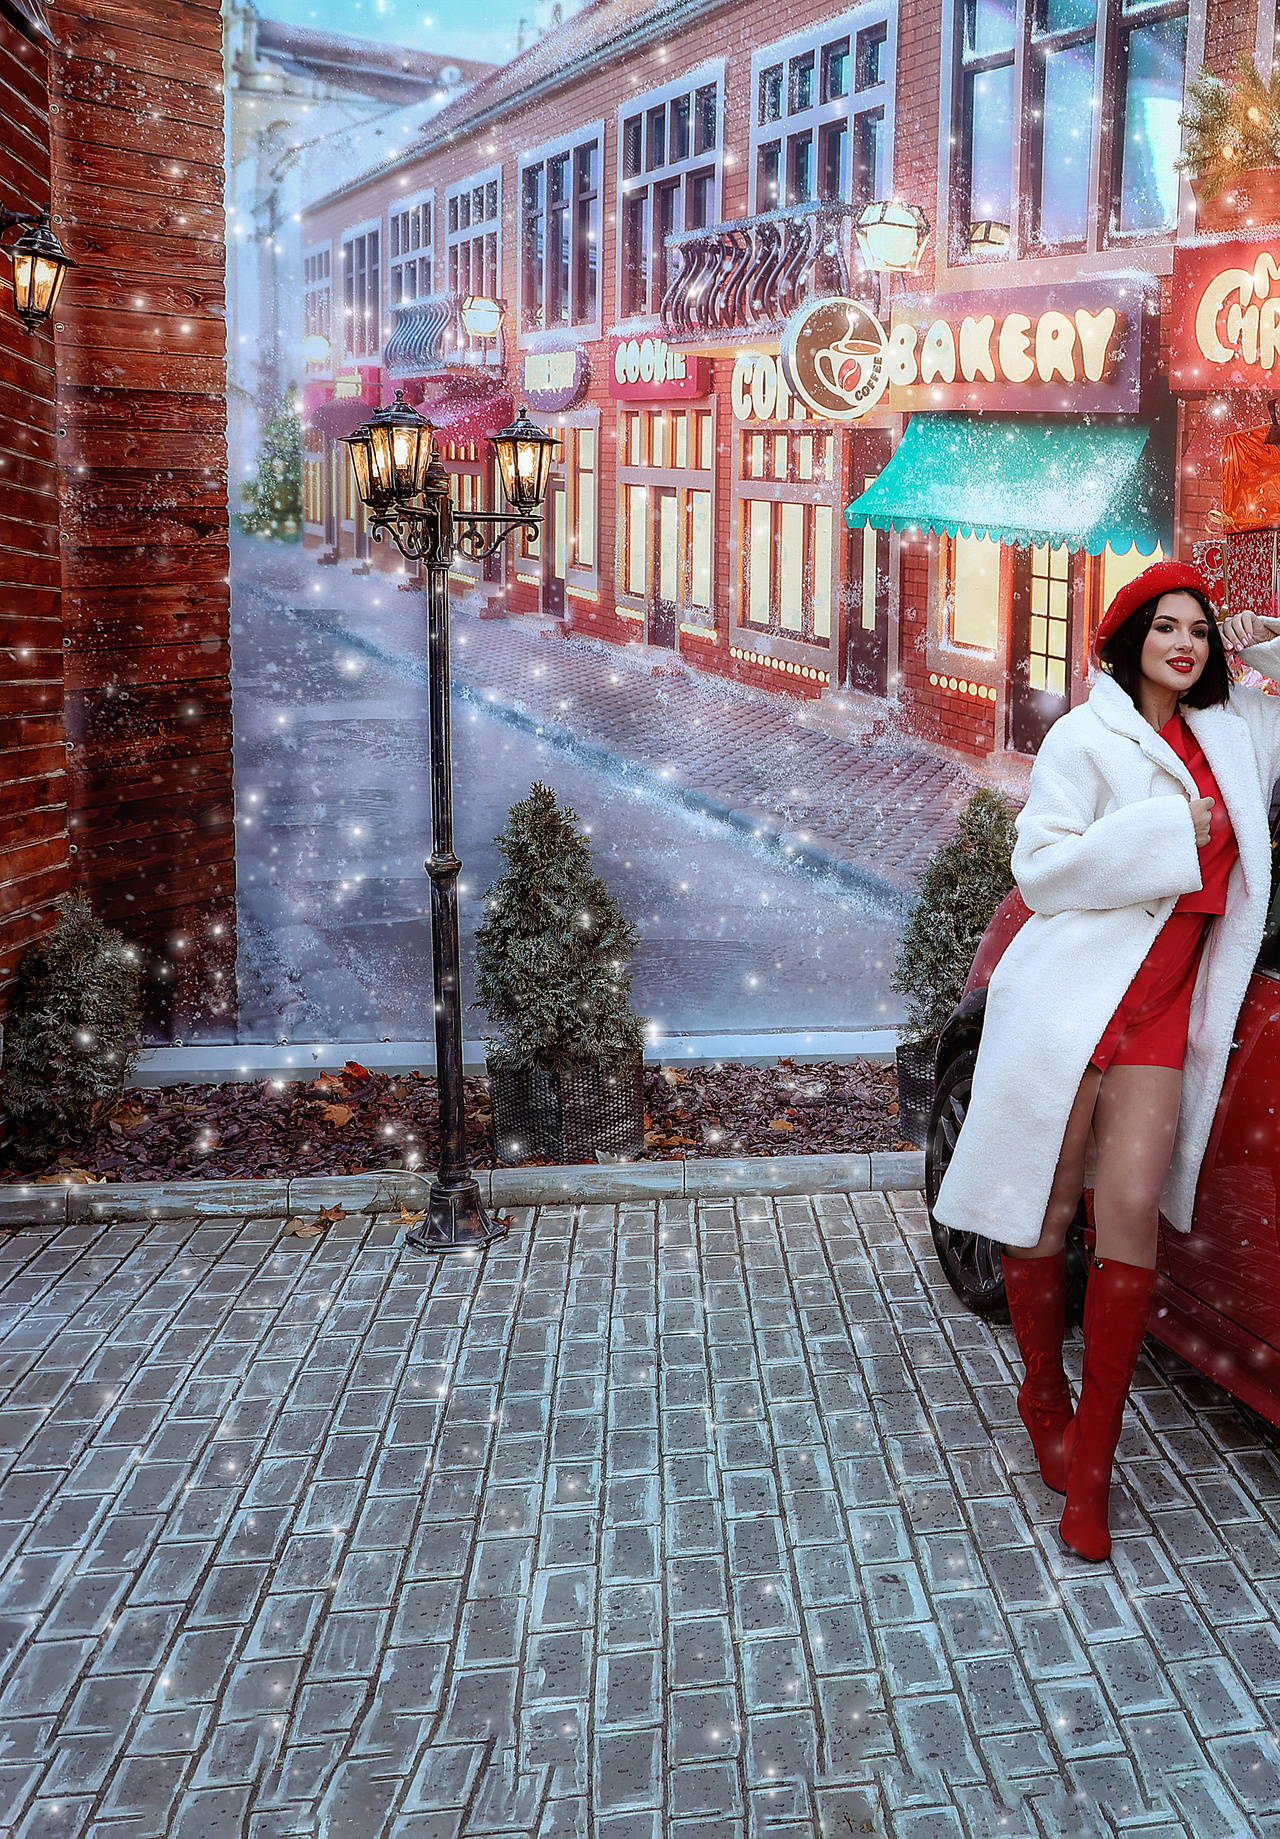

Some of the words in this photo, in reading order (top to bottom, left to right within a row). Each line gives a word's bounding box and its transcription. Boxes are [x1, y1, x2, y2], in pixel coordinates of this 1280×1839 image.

[614, 338, 687, 385] COOKIE
[888, 307, 1117, 386] BAKERY
[854, 356, 883, 402] COFFEE
